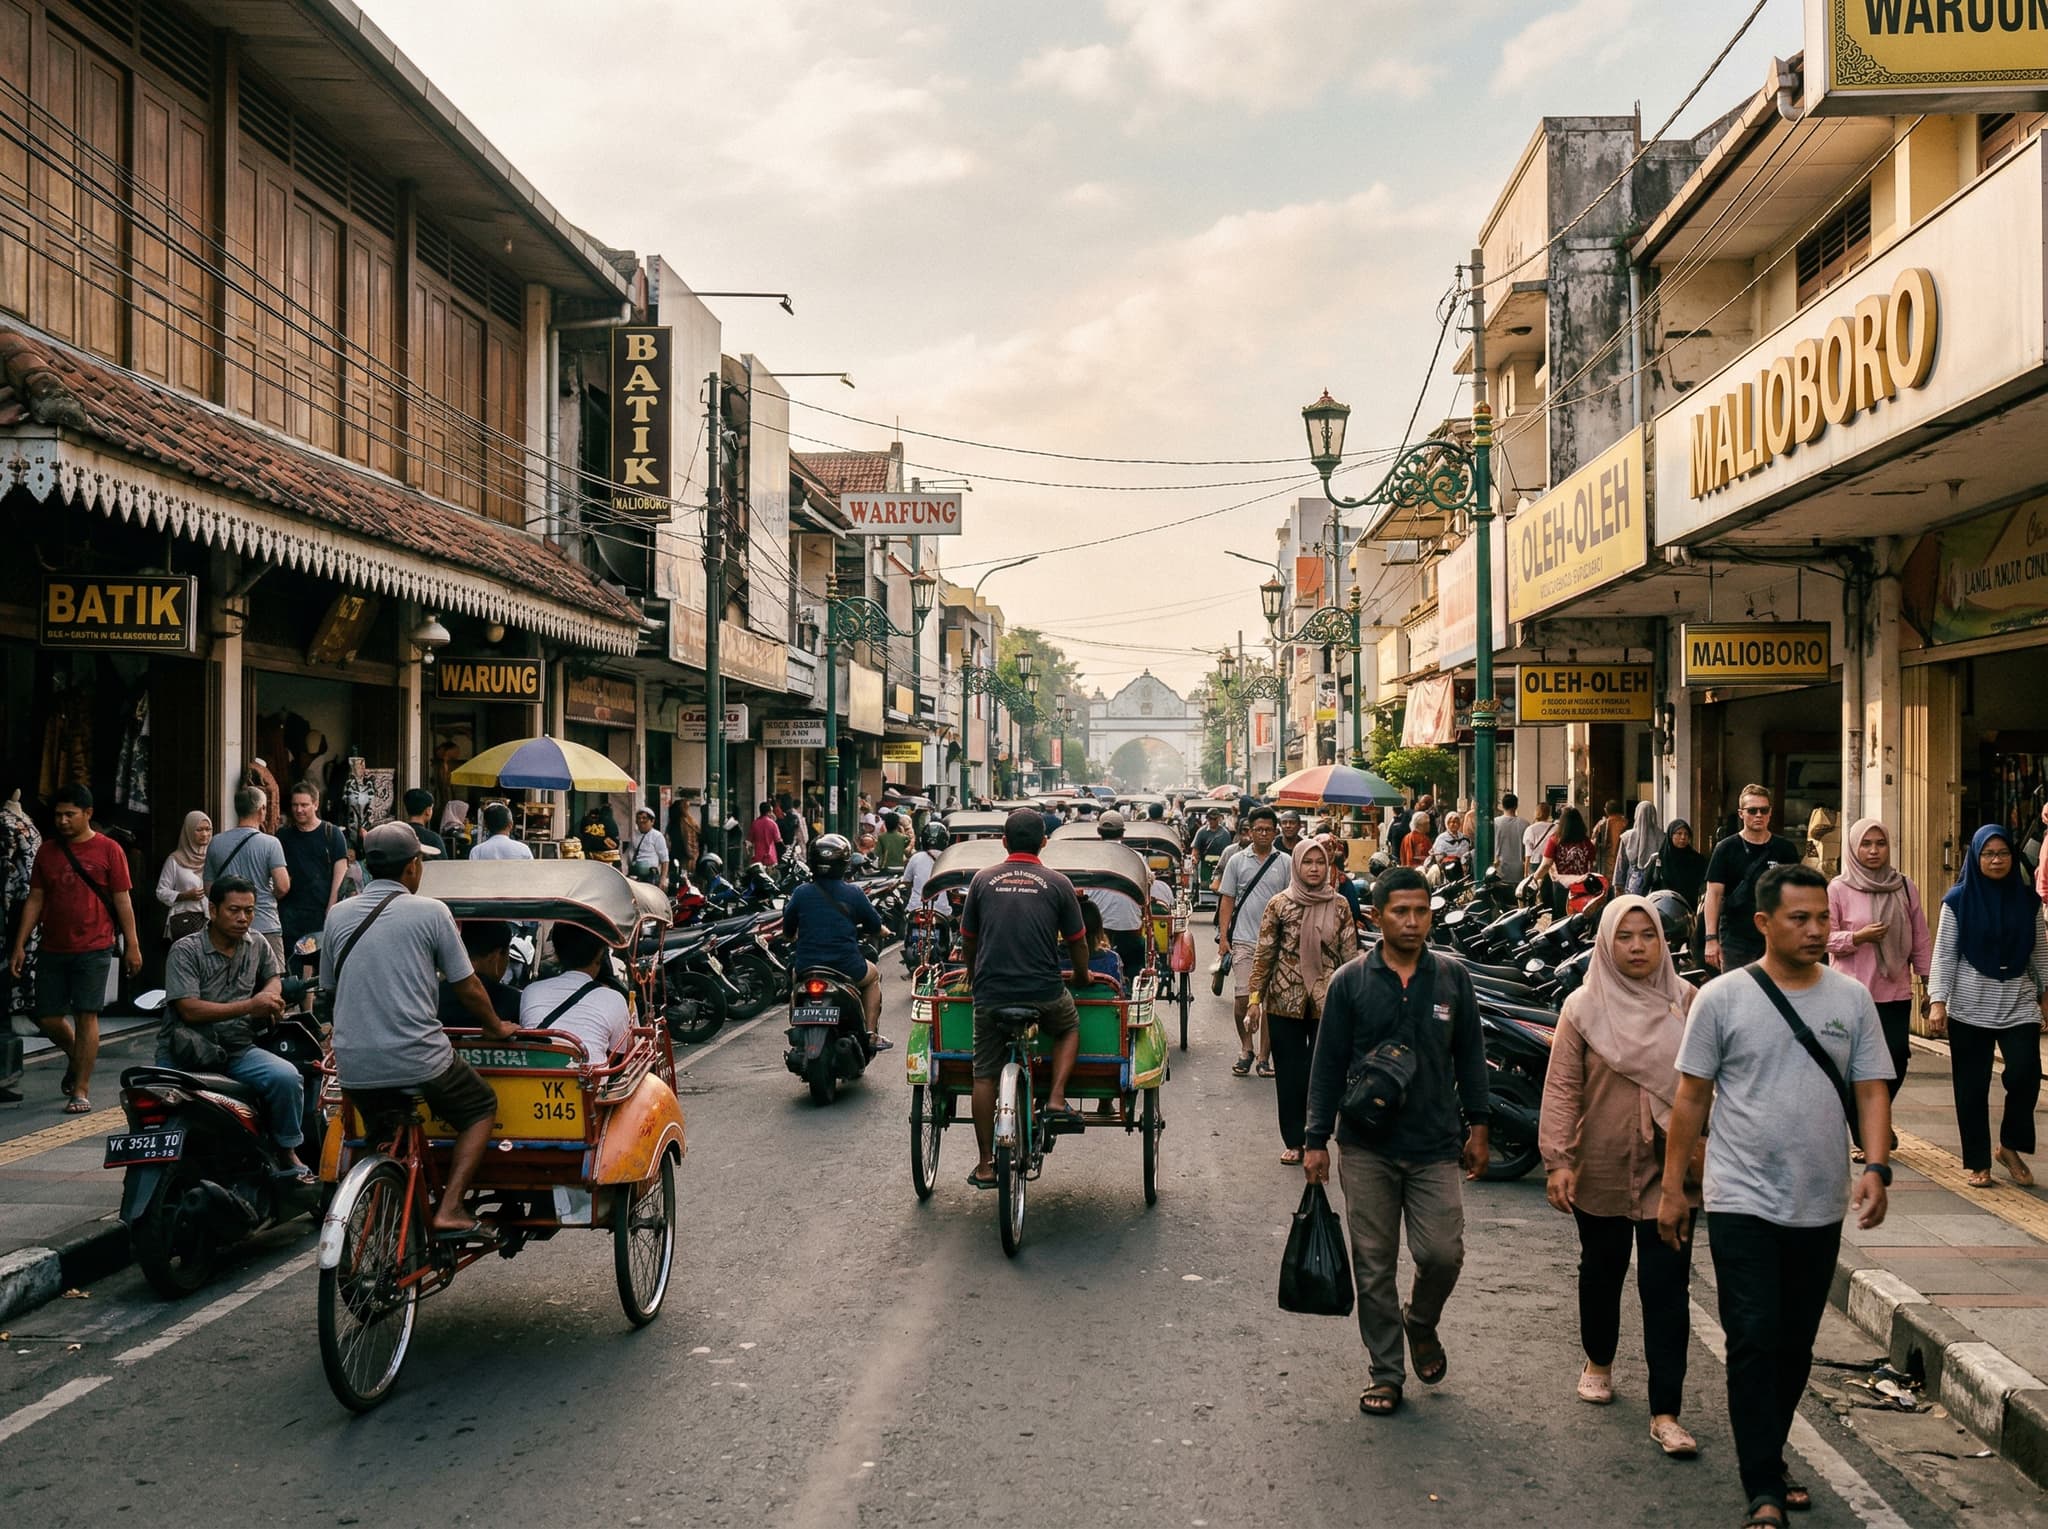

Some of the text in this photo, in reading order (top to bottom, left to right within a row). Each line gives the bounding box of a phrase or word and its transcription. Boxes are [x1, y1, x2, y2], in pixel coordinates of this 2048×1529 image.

[1690, 267, 1938, 501] MALIOBORO
[622, 334, 662, 485] BATIK
[848, 501, 957, 524] WARFUNG
[1521, 457, 1631, 583] OLEH-OLEH
[48, 583, 182, 626] BATIK
[1692, 640, 1823, 667] MALIOBORO
[441, 663, 538, 695] WARUNG
[1525, 671, 1648, 693] OLEH-OLEH
[542, 1081, 566, 1099] YK
[533, 1102, 576, 1120] 3145
[128, 1136, 156, 1150] 3521
